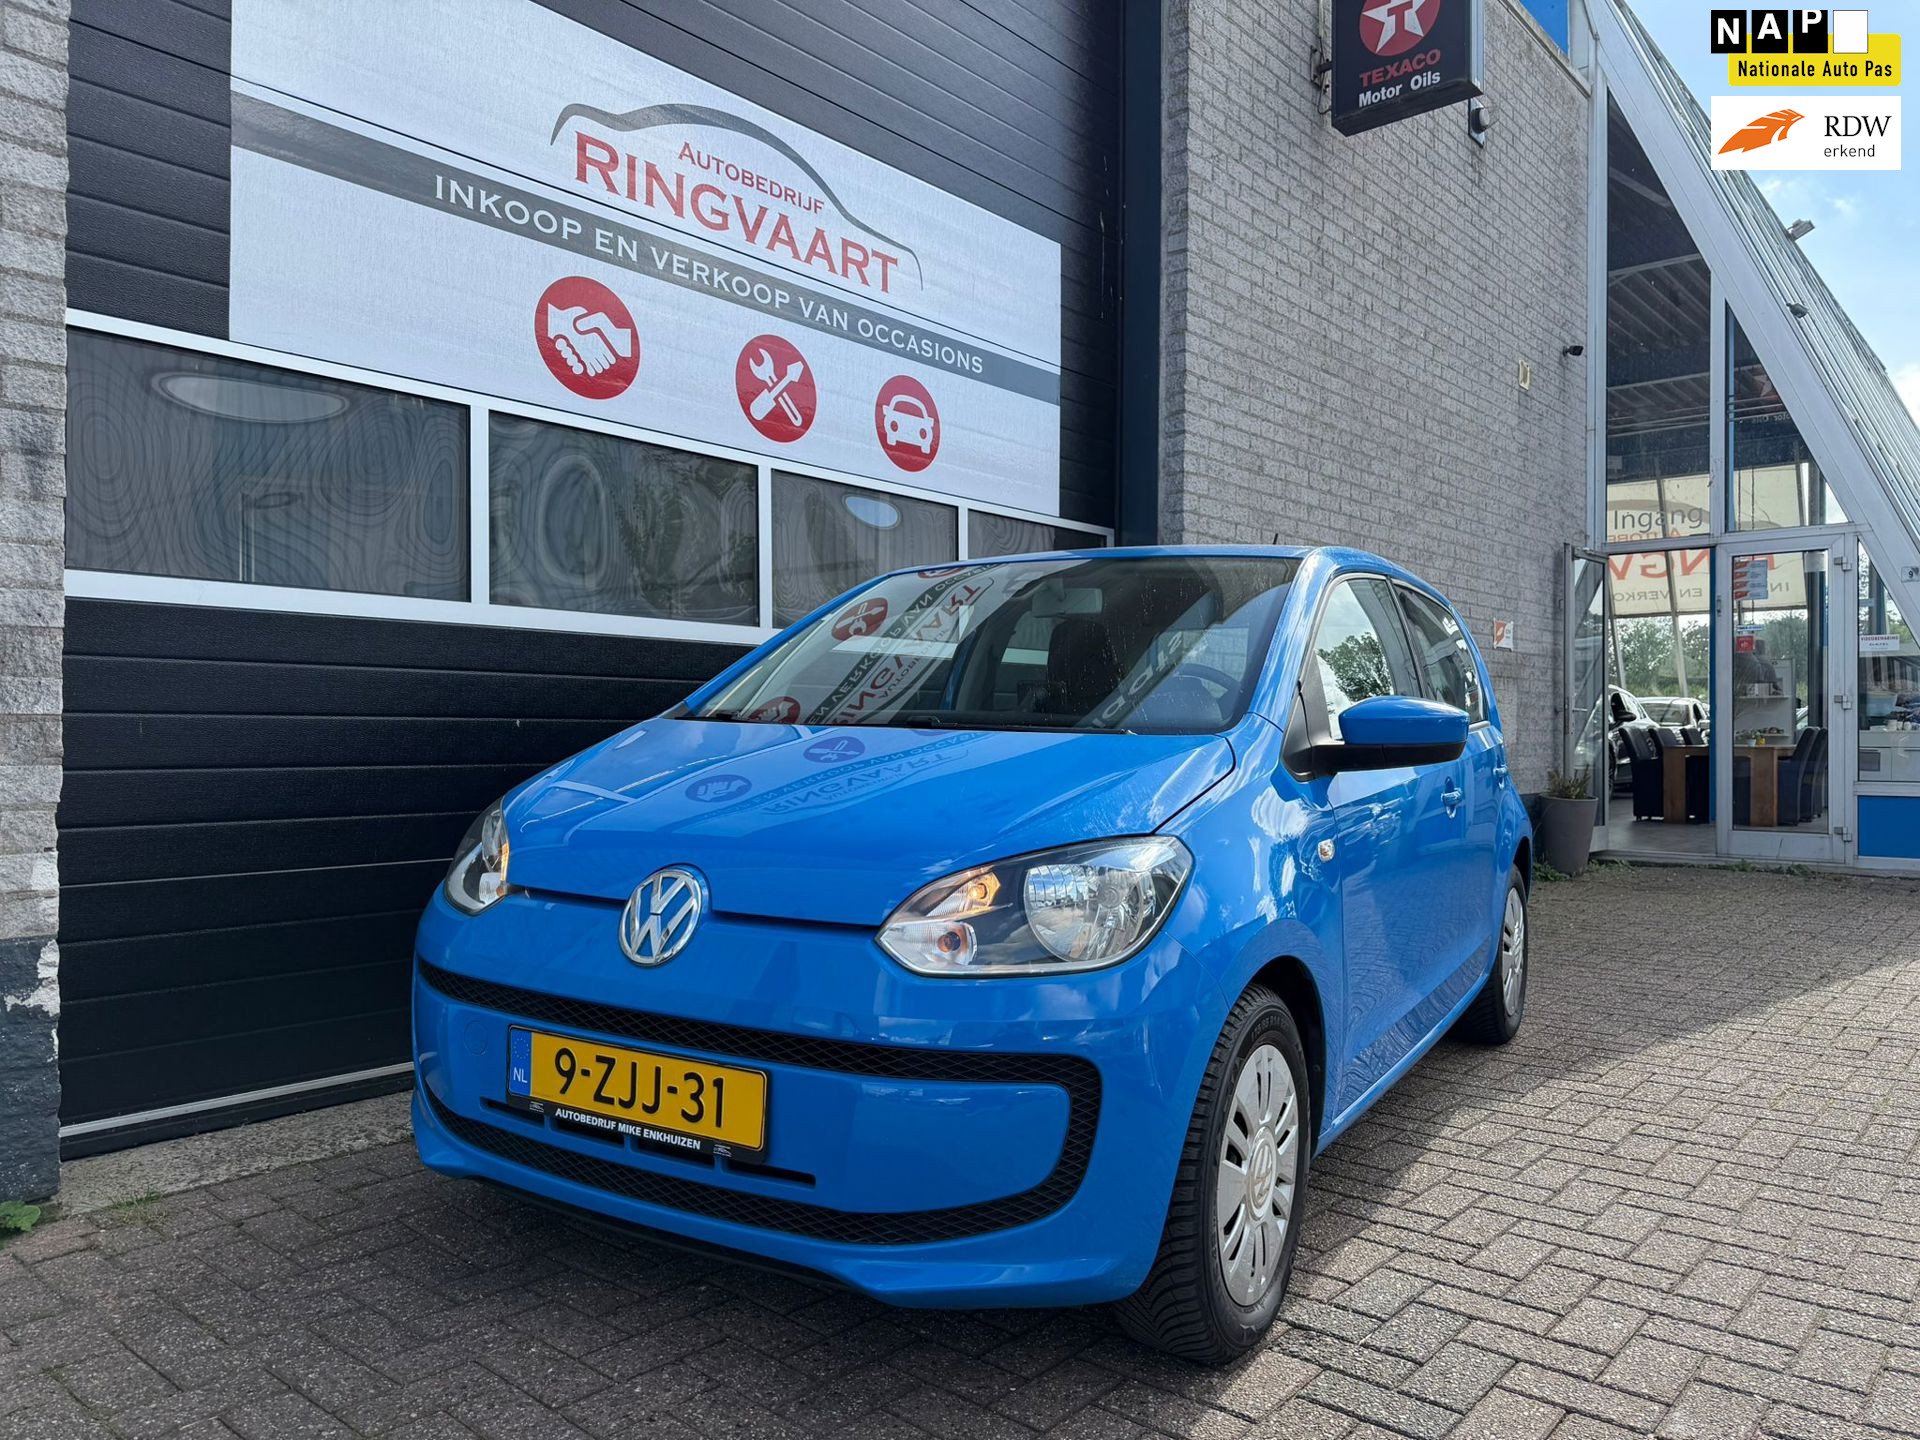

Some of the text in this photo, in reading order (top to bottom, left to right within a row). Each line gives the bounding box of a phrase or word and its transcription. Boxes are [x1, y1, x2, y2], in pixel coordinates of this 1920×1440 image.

[1359, 49, 1441, 87] TEXACO
[1359, 71, 1441, 108] Motor Oils
[678, 141, 825, 215] AUTOBEDRIJF
[574, 131, 899, 294] RINGVAART
[435, 174, 985, 375] INKOOP EN VERKOOP VAN OCCASIONS
[1614, 508, 1702, 533] Ingang
[513, 1047, 725, 1128] NL 9-ZJJ-31
[555, 1107, 616, 1131] AUTOBEDRIJF
[618, 1123, 642, 1137] MIKE
[643, 1128, 701, 1150] ENKHUIZEN
